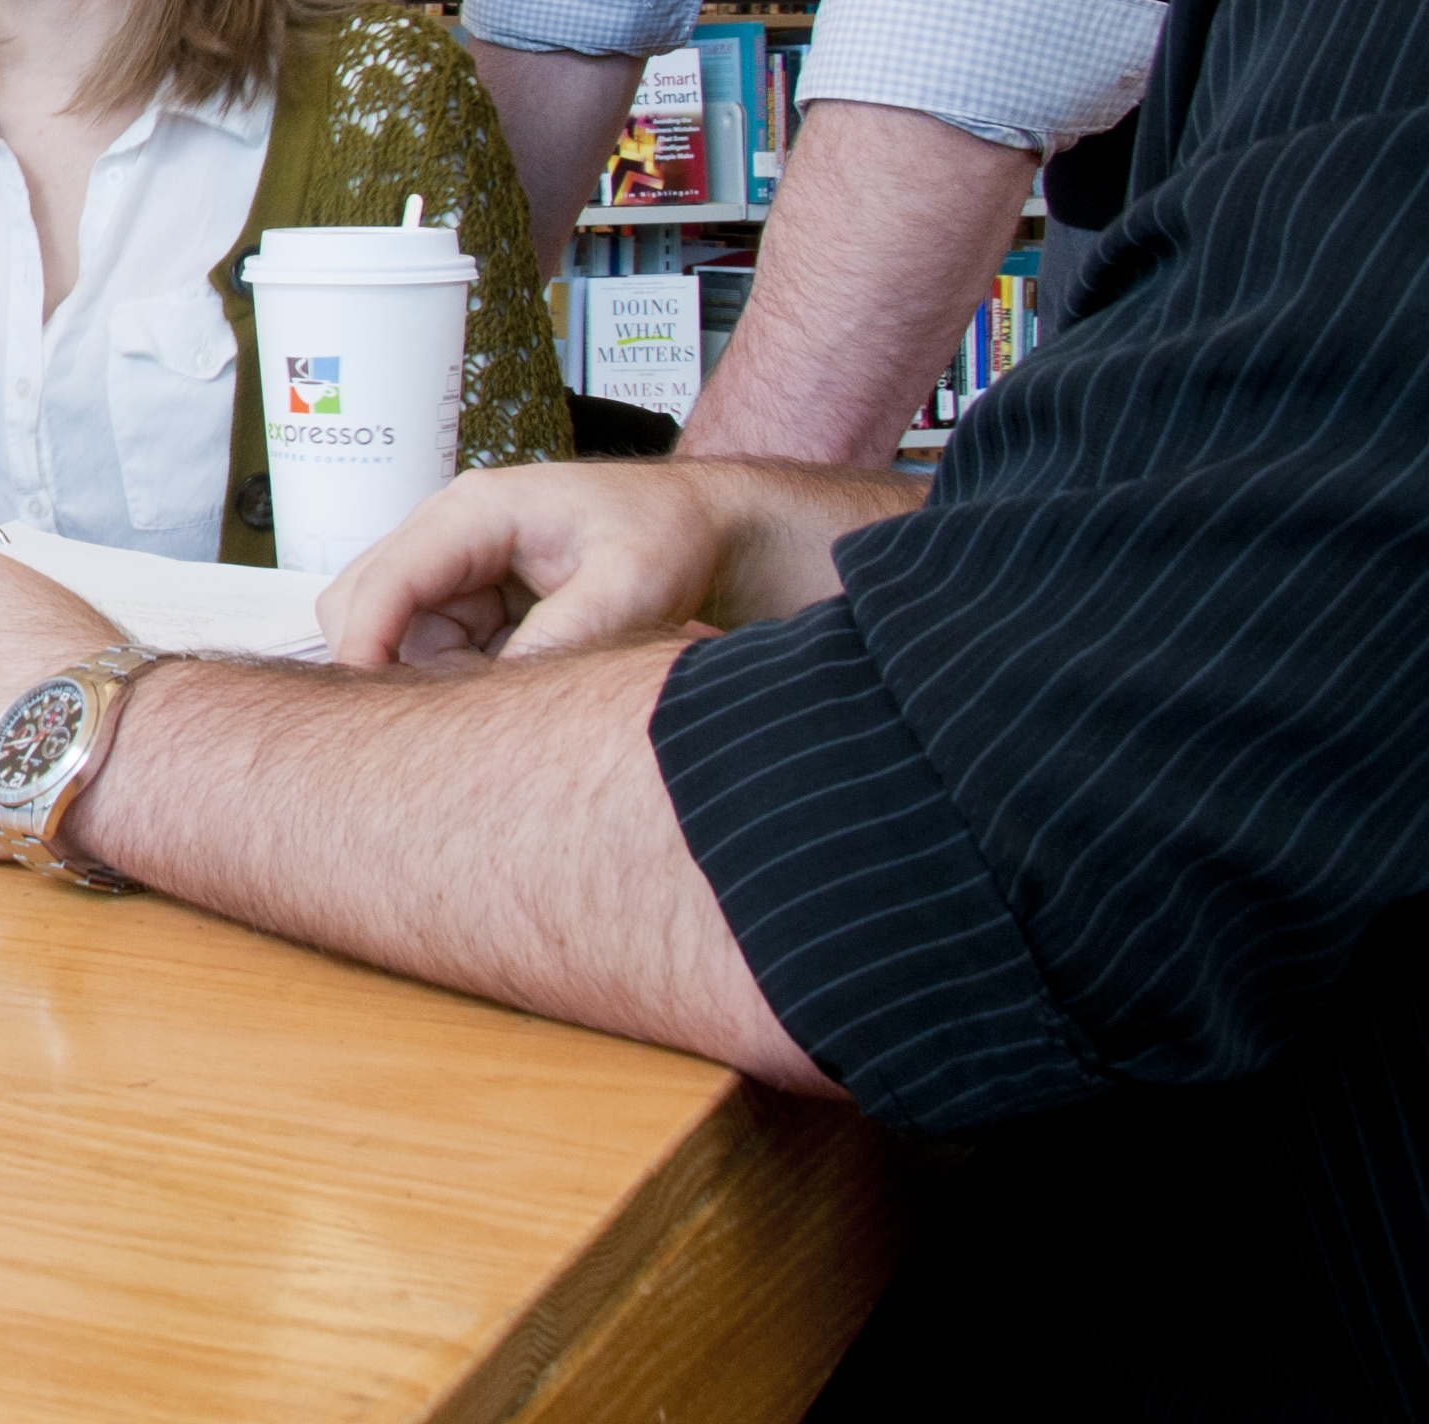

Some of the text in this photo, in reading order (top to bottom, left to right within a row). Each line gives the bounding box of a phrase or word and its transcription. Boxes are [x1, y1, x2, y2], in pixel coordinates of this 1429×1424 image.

[653, 72, 698, 87] Smart
[654, 90, 700, 105] Smart
[640, 188, 700, 199] Nightingale
[612, 299, 679, 316] DOING
[615, 322, 676, 338] WHAT
[992, 297, 1001, 372] ALLIANCE BRAND
[597, 345, 696, 364] MATTERS
[604, 381, 692, 398] JAMES M.
[313, 455, 394, 464] COMPANY
